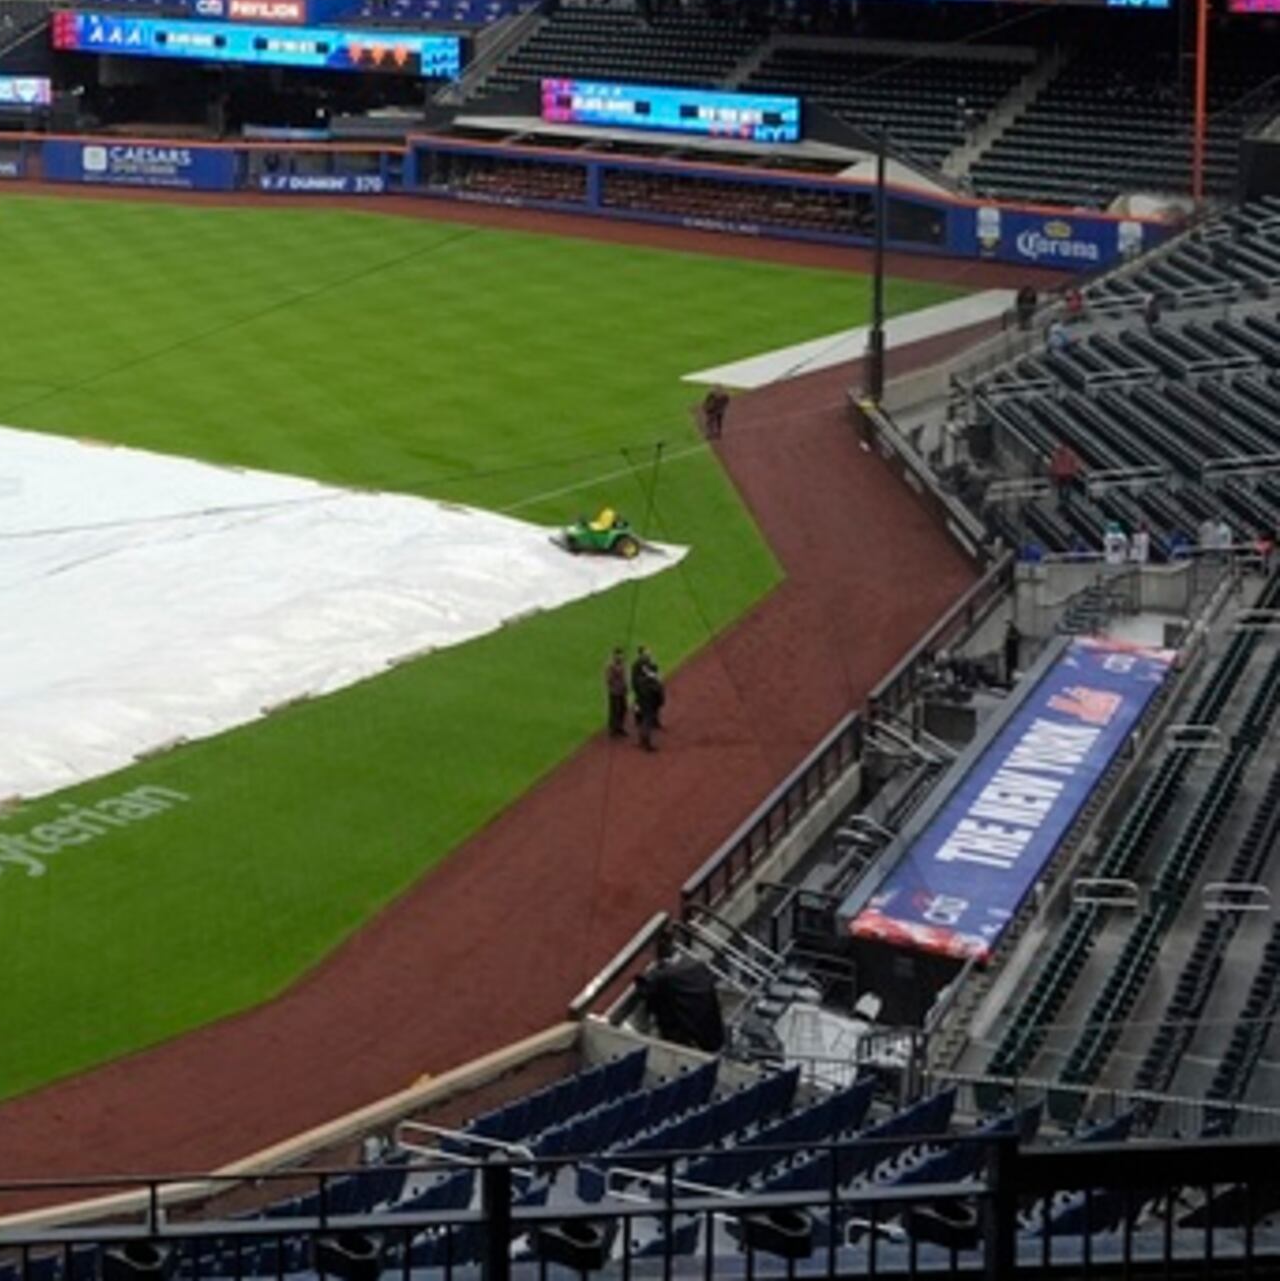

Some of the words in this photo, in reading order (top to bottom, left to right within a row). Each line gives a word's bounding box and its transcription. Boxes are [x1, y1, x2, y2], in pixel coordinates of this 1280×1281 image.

[109, 147, 192, 166] CAESARS
[1016, 231, 1099, 261] Corona
[935, 815, 1035, 870] THE
